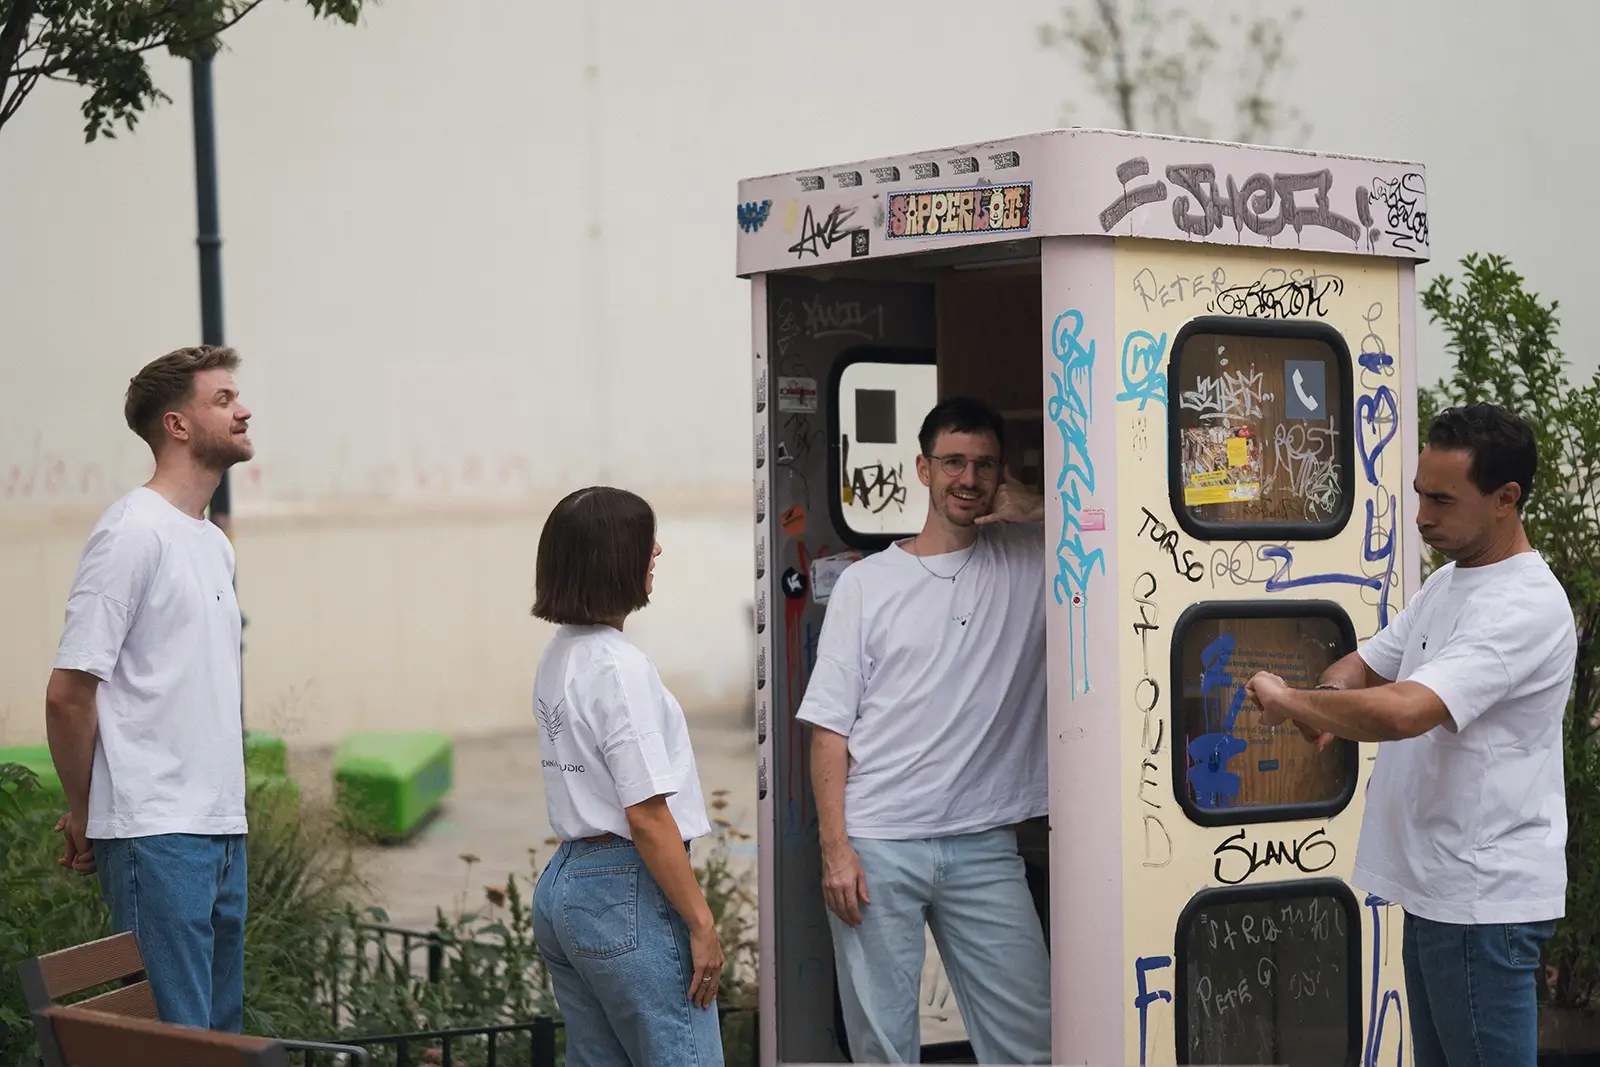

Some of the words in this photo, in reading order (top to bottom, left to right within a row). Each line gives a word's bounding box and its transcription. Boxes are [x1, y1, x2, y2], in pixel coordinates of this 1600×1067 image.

[988, 151, 1012, 160] HARDCORE
[948, 157, 972, 165] HARDCORE
[1213, 828, 1337, 884] SLANG
